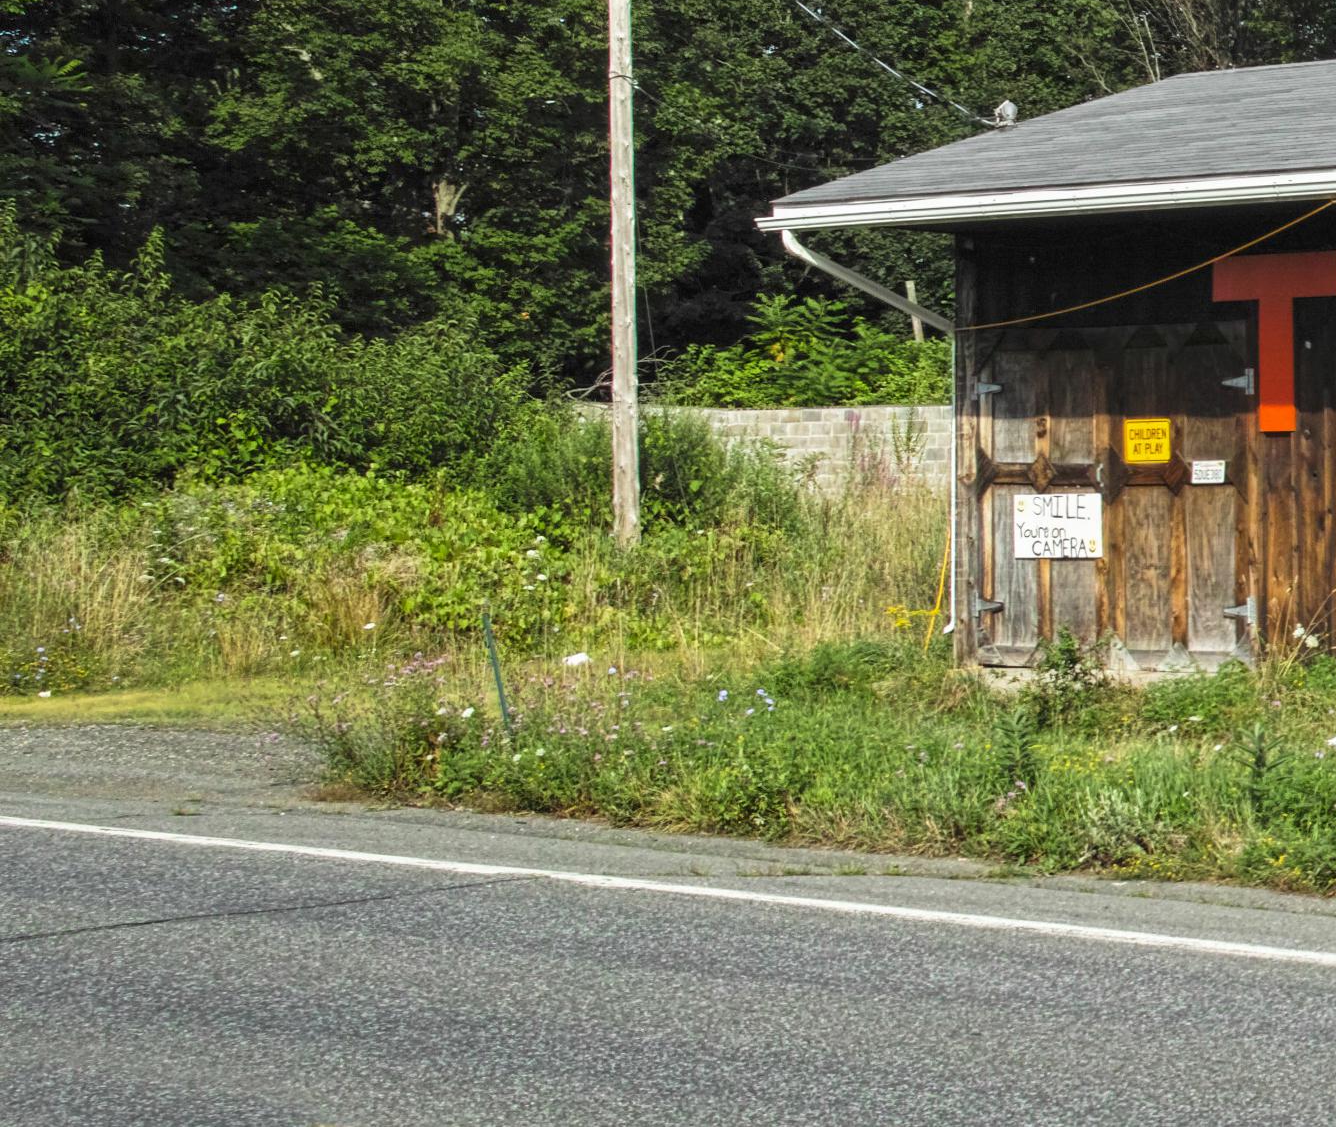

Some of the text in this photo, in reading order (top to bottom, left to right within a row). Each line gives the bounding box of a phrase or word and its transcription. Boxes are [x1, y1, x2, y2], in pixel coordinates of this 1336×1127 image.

[1129, 428, 1167, 440] CHILDREN
[1133, 443, 1163, 455] AT PLAY
[1051, 527, 1067, 539] on
[1031, 537, 1088, 559] CAMERA
